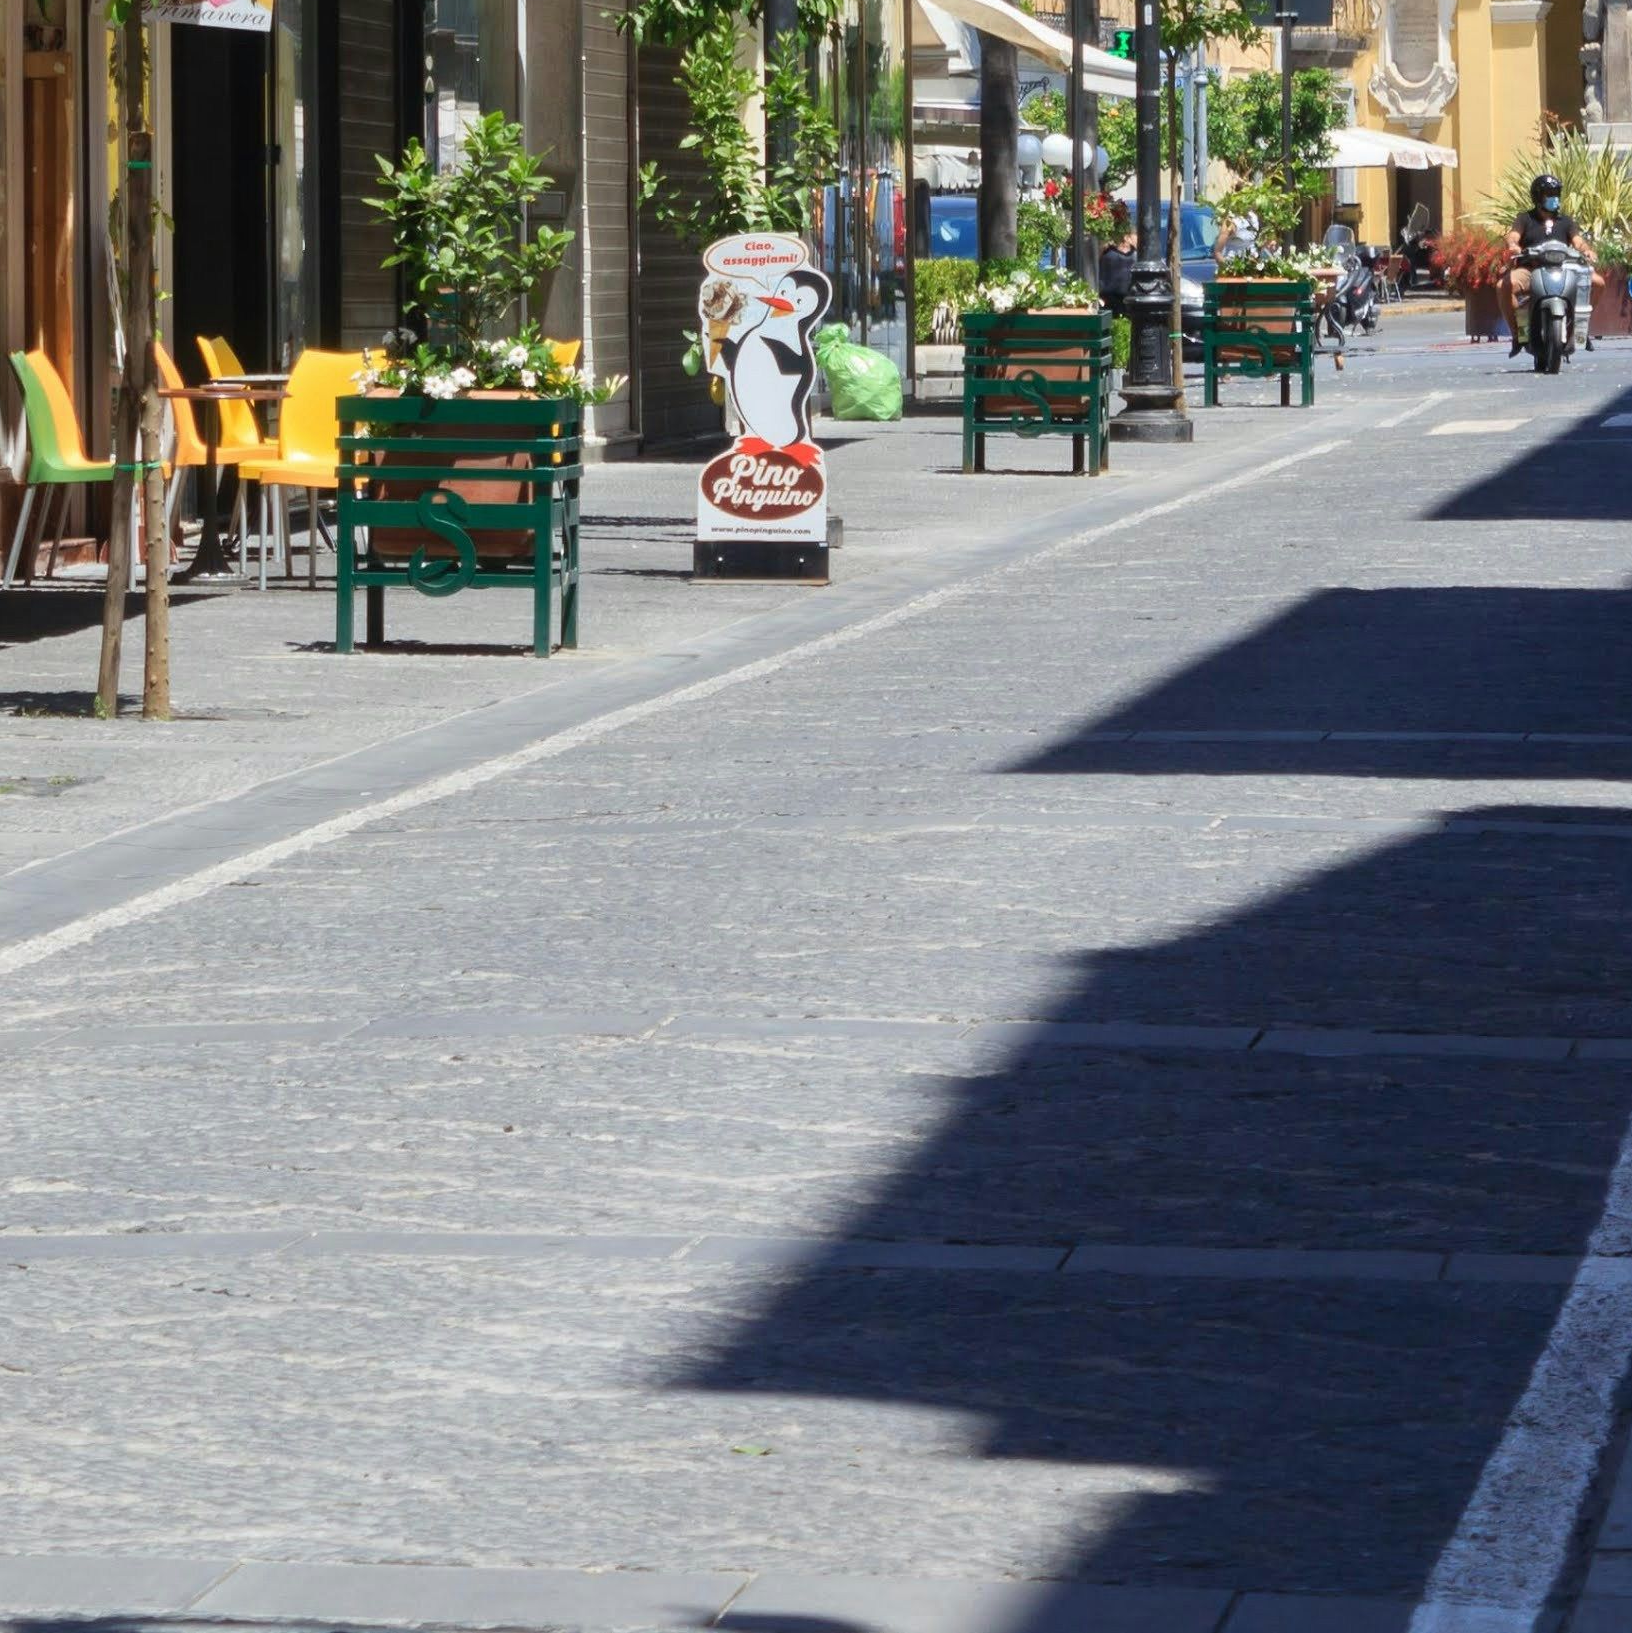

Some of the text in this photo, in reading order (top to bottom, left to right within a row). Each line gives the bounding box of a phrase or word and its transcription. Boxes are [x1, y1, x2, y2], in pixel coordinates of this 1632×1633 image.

[744, 241, 775, 251] Ciao,
[722, 253, 798, 266] assaggiami!
[730, 453, 805, 487] Pino
[713, 477, 817, 512] Pinguino
[711, 526, 811, 535] www.pinopinguino.com
